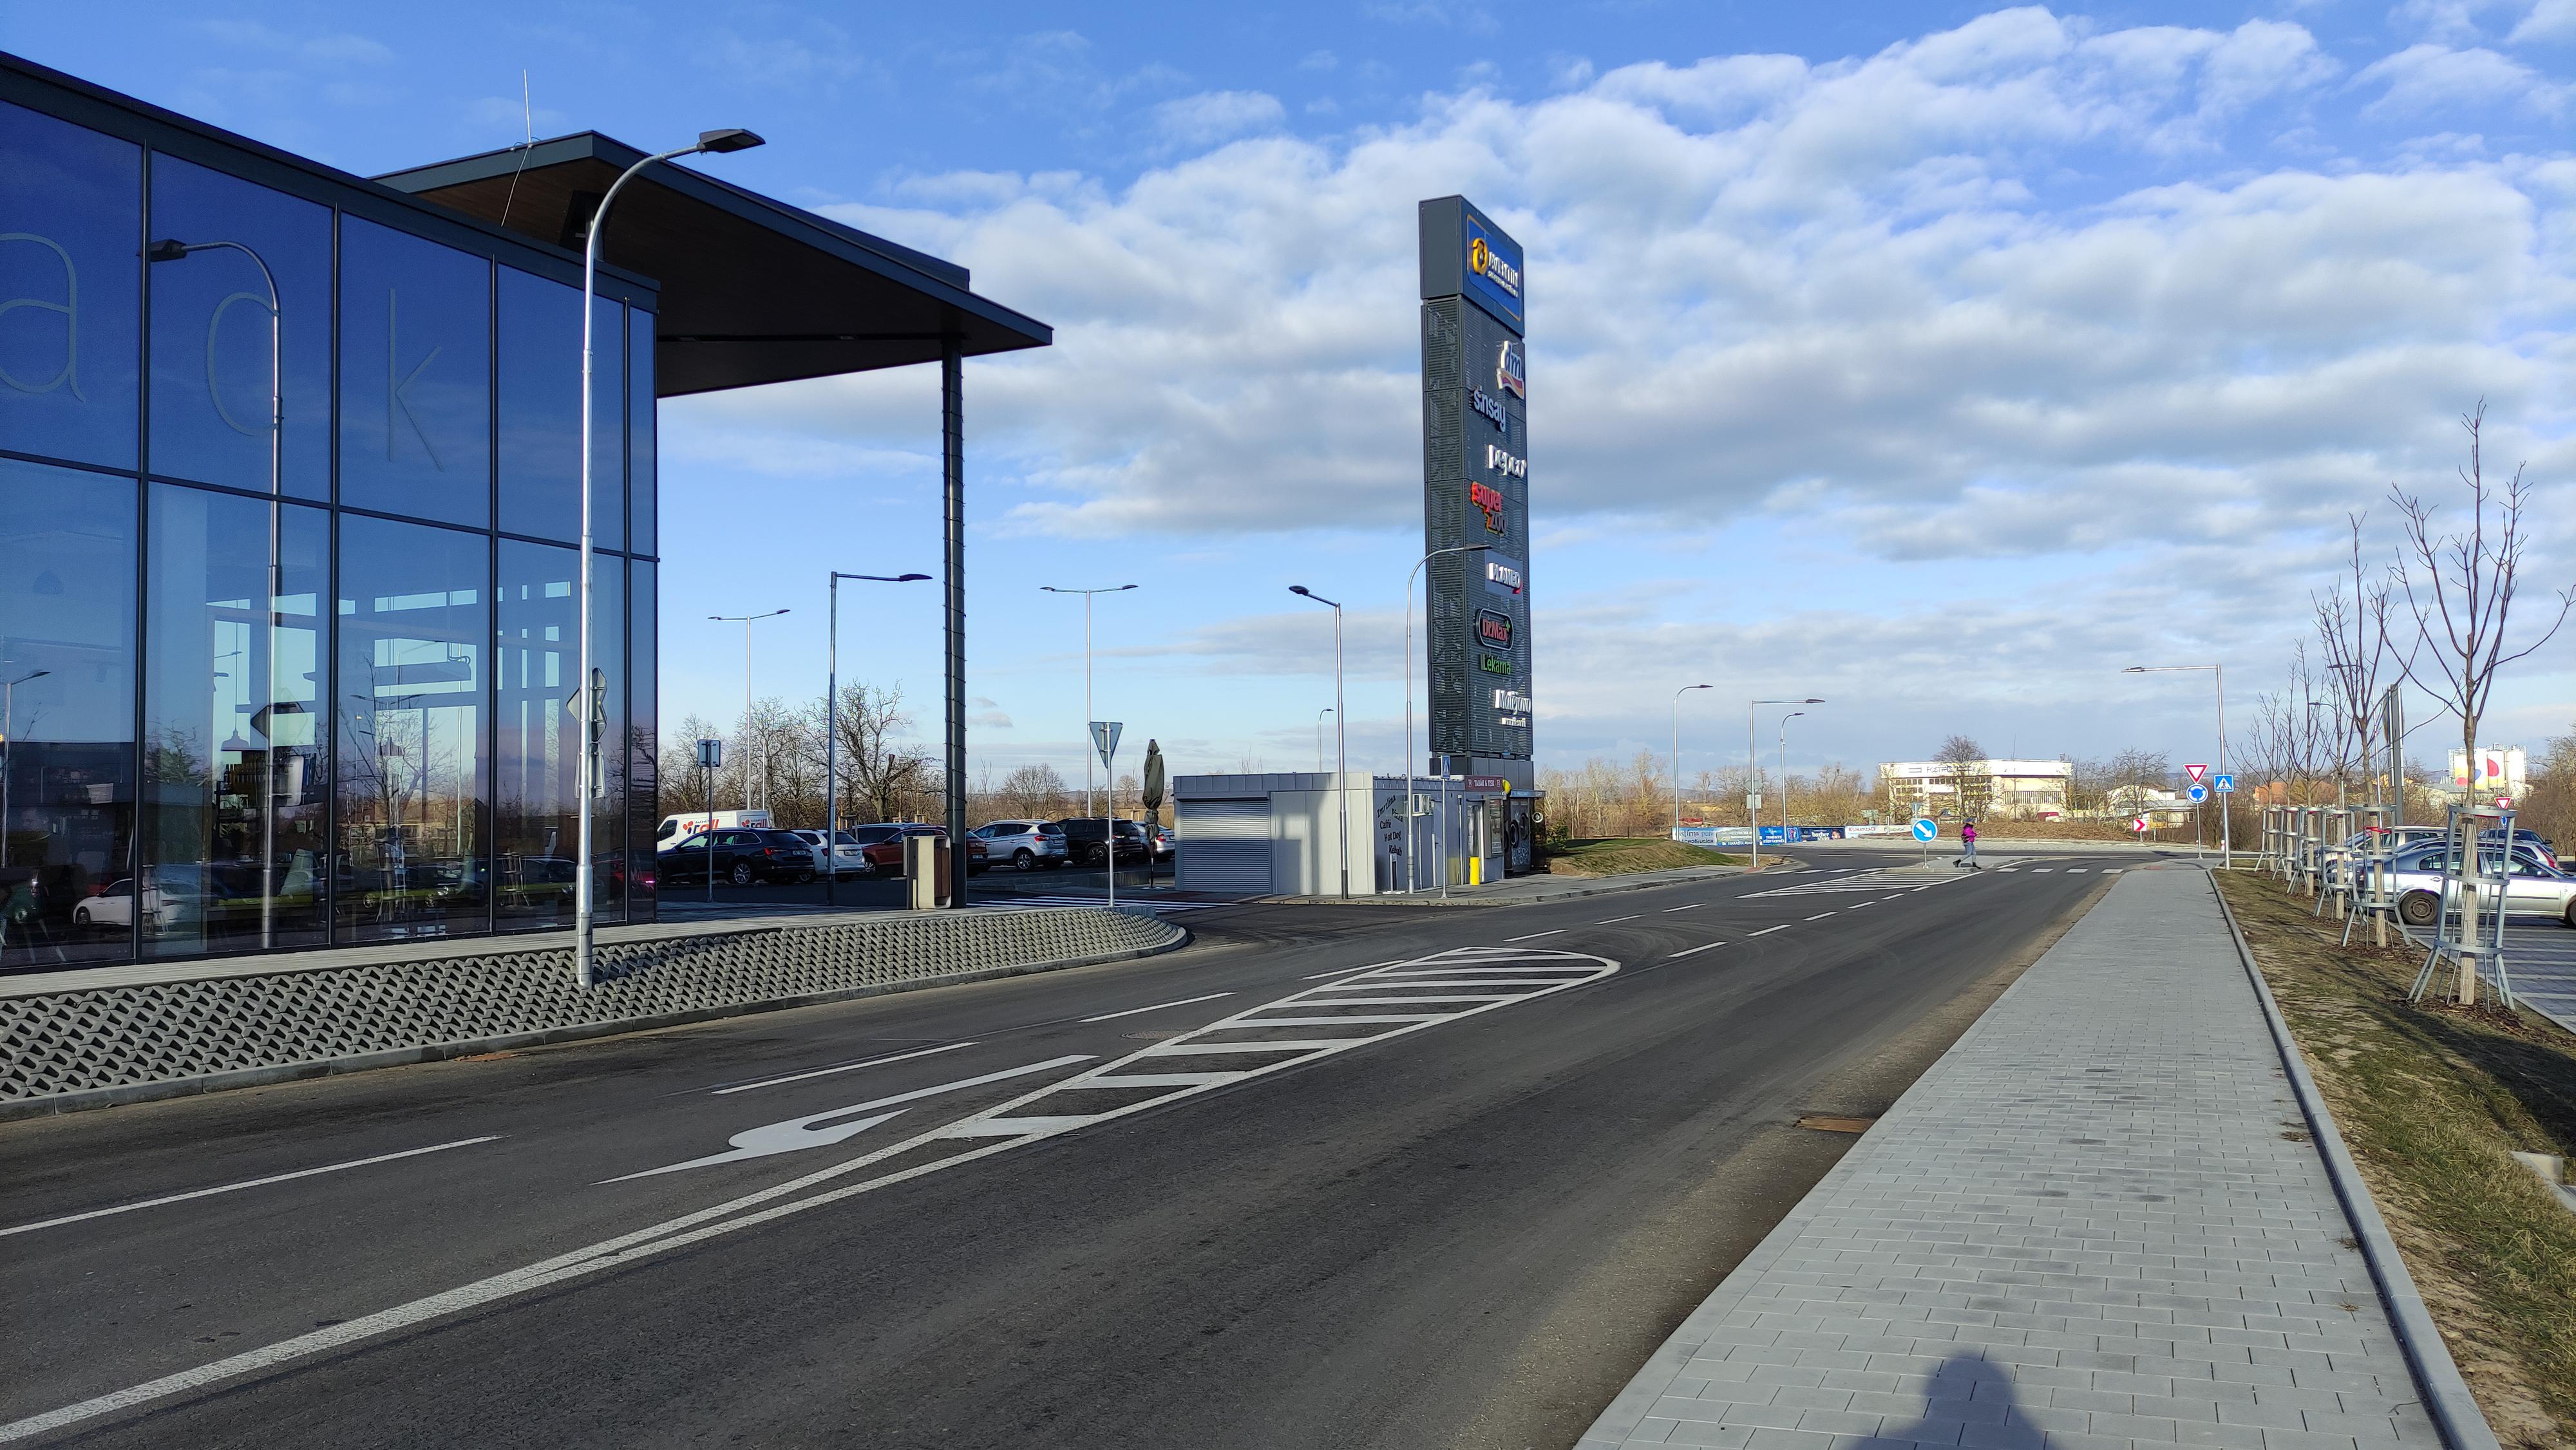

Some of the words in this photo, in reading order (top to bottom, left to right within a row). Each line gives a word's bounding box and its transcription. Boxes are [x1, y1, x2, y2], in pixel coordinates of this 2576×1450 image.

[1473, 386, 1506, 432] sinsay
[1472, 484, 1503, 513] super
[1377, 795, 1396, 818] Zmrzlina
[1392, 809, 1403, 822] Pizza
[1389, 845, 1402, 856] Kebab
